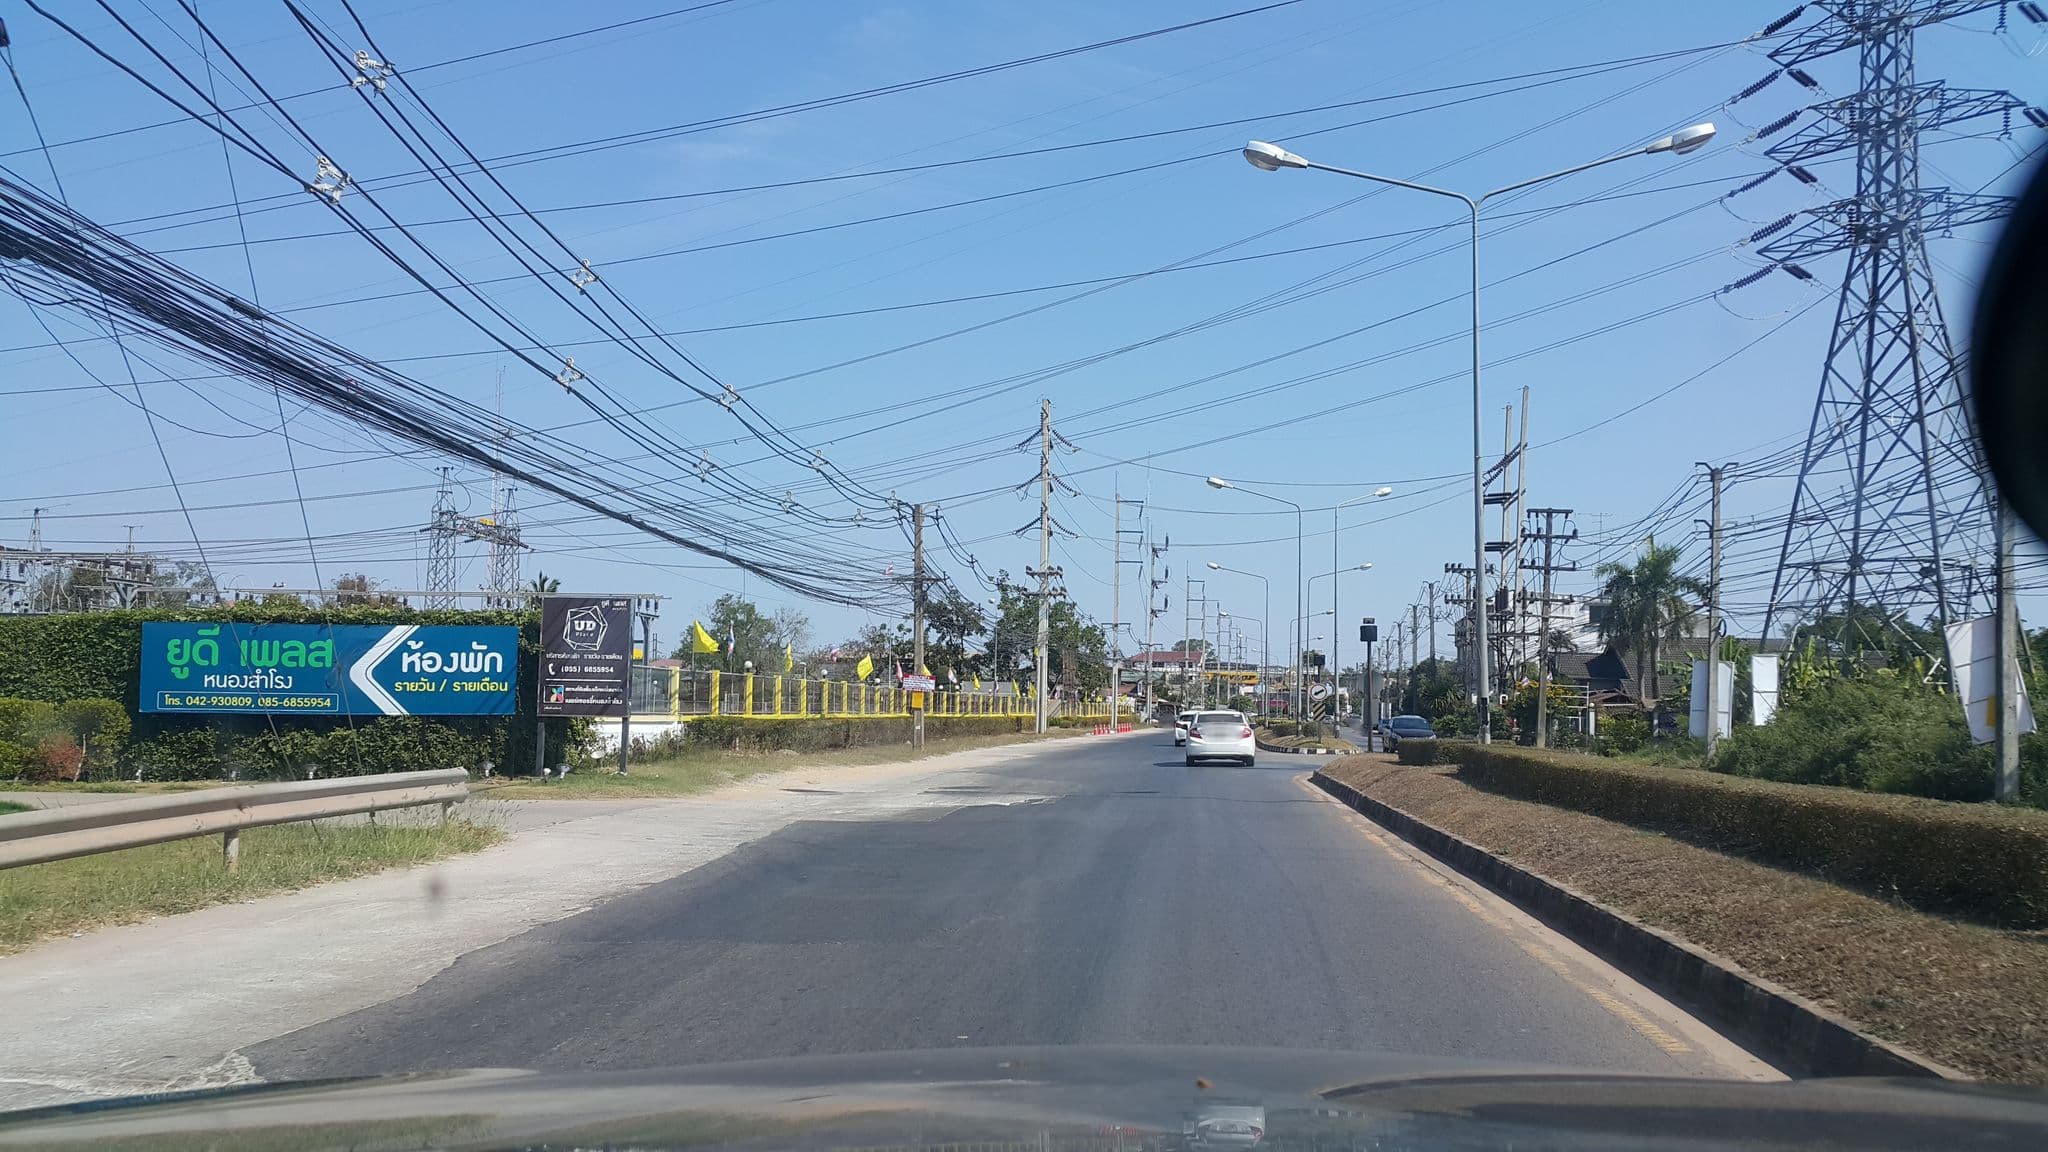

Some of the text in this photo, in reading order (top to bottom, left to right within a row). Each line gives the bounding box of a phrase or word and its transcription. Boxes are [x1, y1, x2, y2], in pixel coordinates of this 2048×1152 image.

[574, 620, 597, 631] UD
[166, 624, 333, 679] ยูดี เพลส
[402, 640, 503, 674] ห้องพัก
[203, 668, 293, 690] หนองสำโรง
[394, 676, 508, 692] รายวัน / รายเดือน
[164, 693, 331, 708] โทร. 042-930809, 085-6855954
